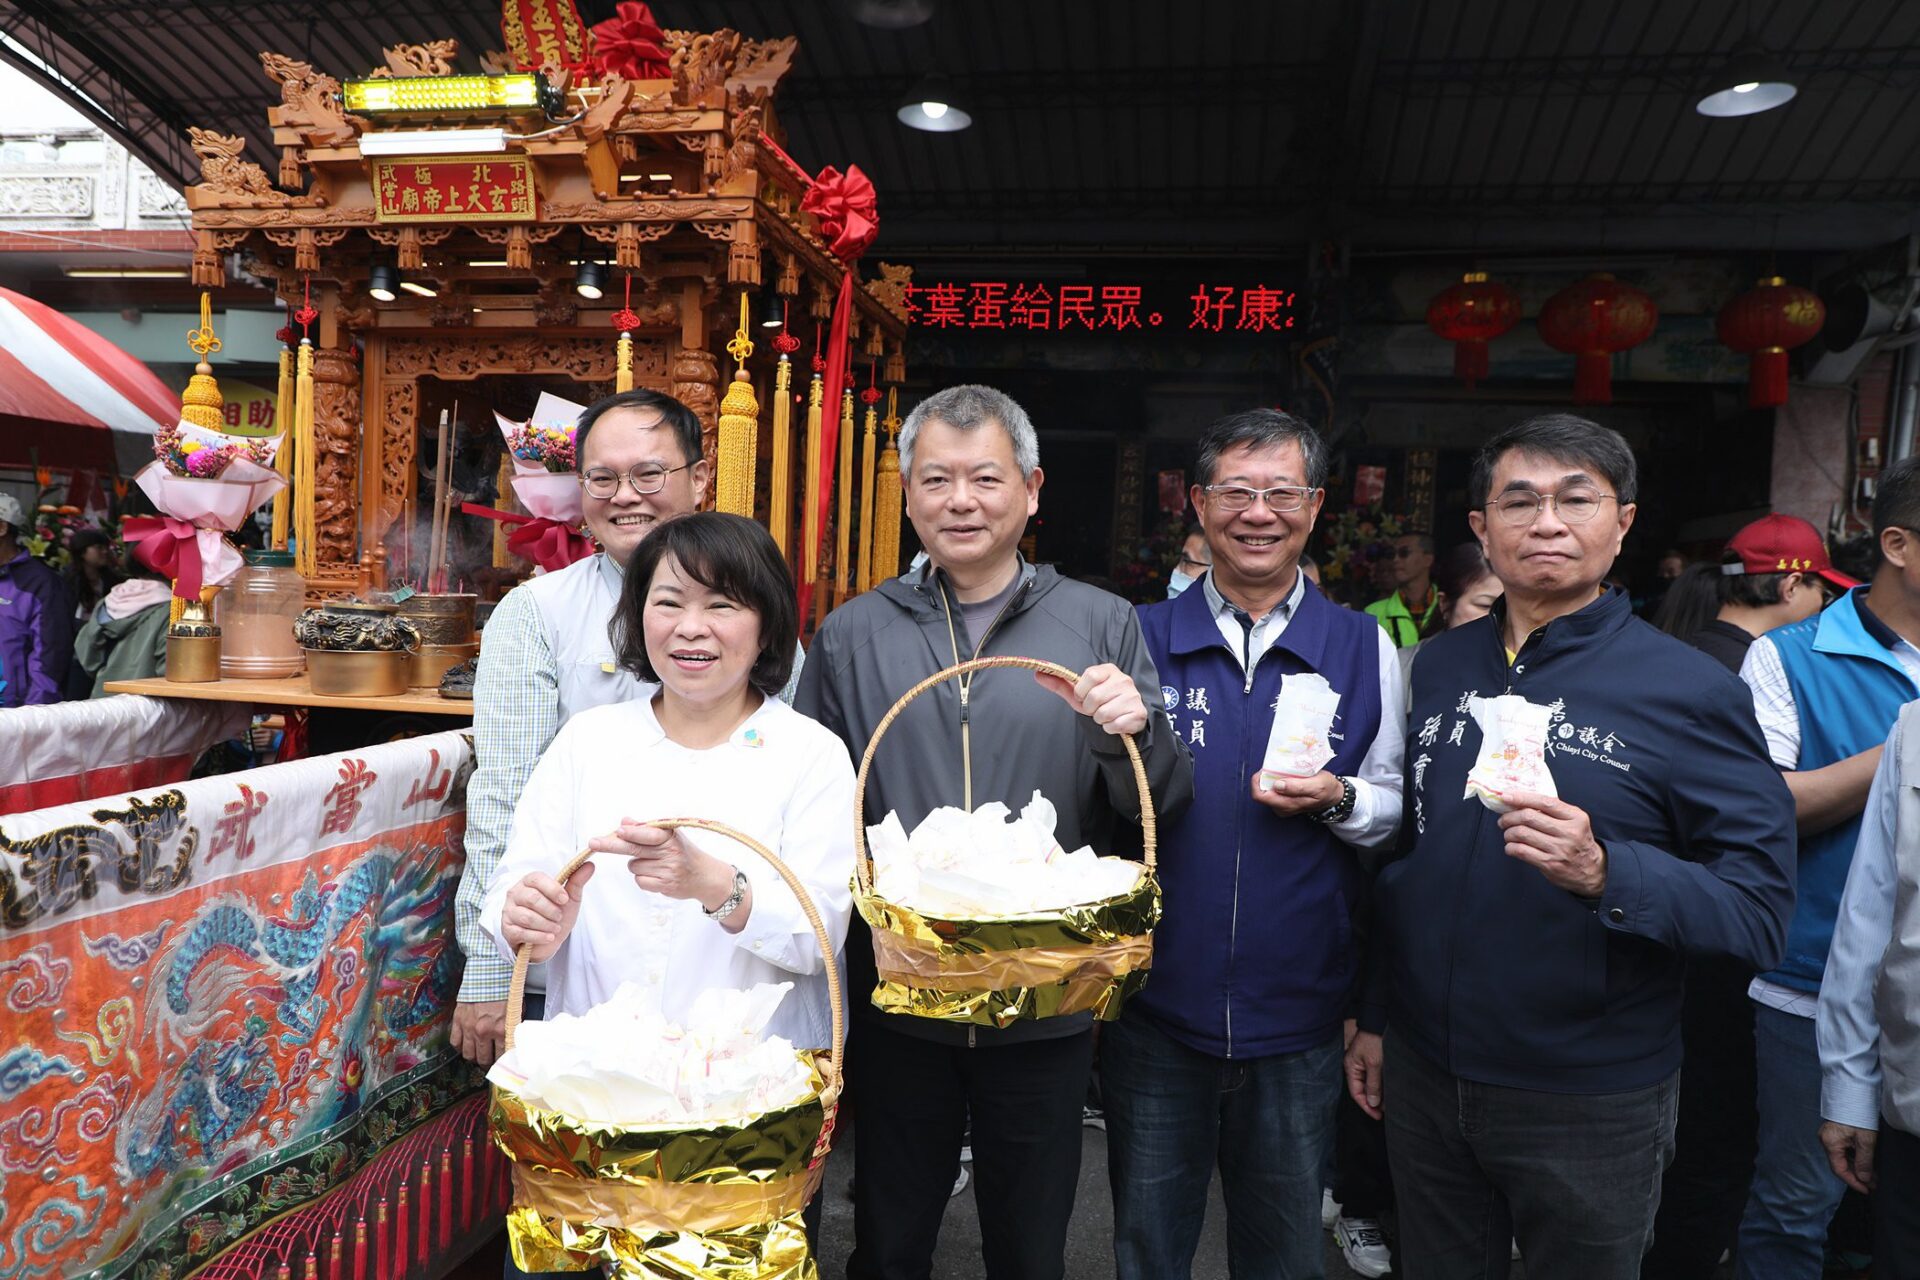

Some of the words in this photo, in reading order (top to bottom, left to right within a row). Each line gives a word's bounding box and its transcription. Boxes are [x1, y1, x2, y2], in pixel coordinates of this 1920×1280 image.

[381, 164, 400, 215] 武當山
[401, 184, 508, 213] 玄天上帝廟
[1186, 687, 1211, 748] 議員
[1581, 749, 1599, 762] City
[1600, 754, 1631, 772] Council
[204, 748, 452, 865] 武當山
